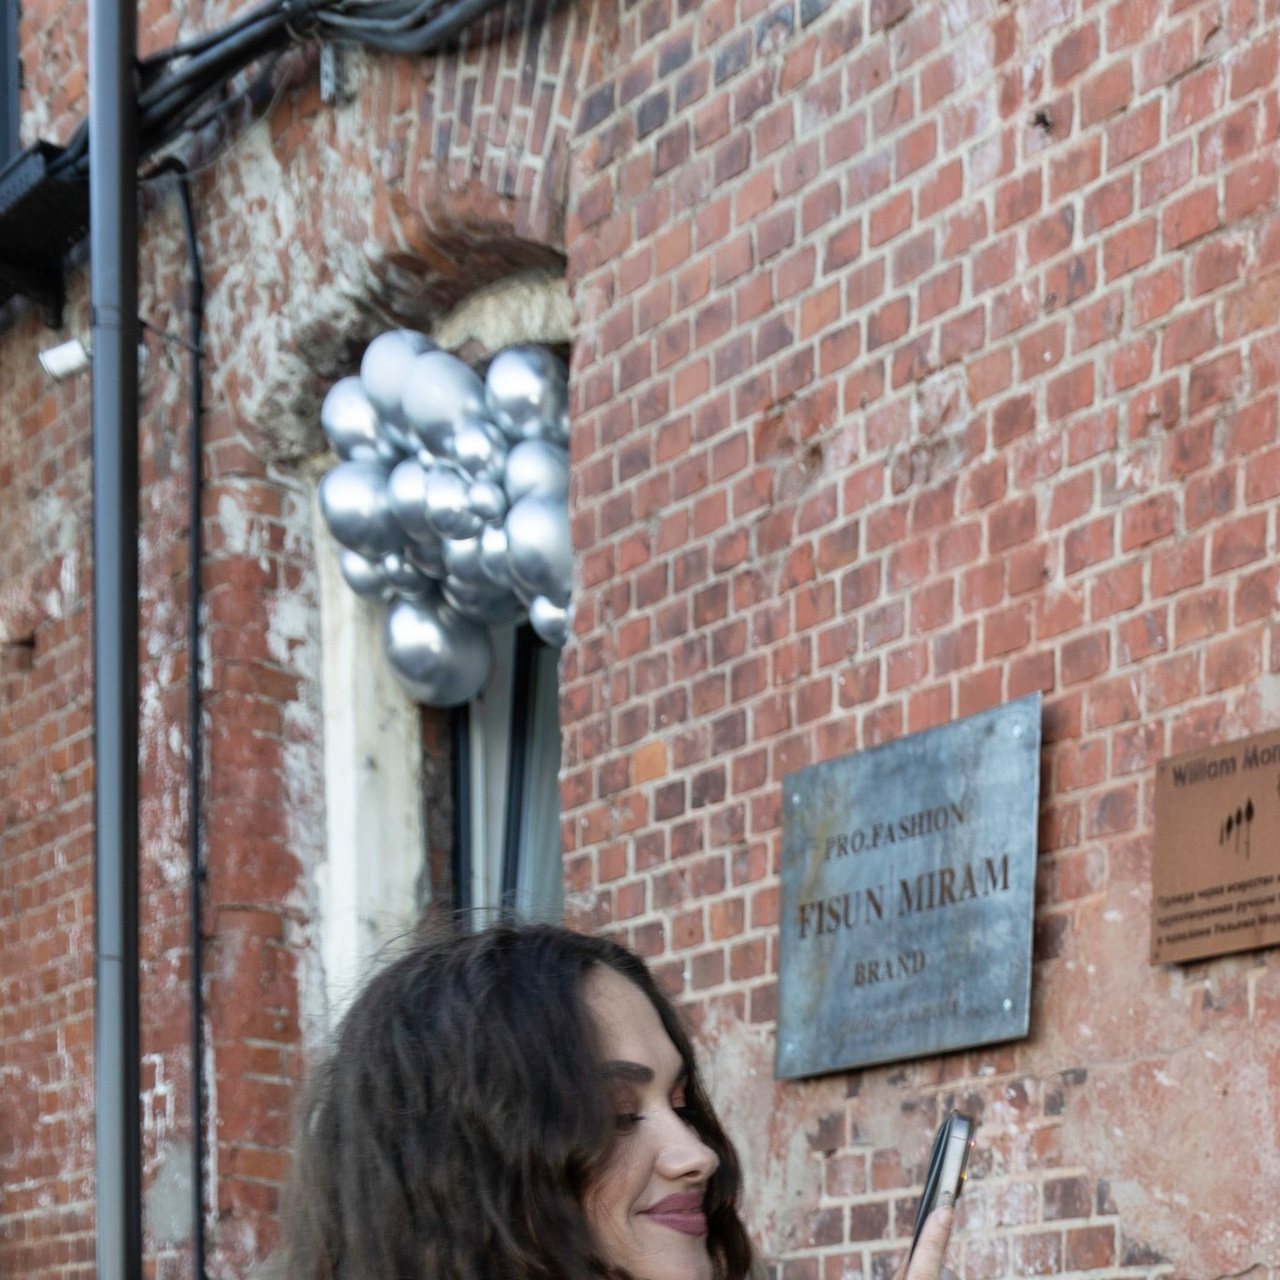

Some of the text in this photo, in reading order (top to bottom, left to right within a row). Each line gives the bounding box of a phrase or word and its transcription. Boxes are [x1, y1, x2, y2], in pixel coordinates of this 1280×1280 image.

[824, 802, 965, 861] PRO.FASHION
[797, 854, 1011, 939] FISUN MIRAM
[853, 950, 927, 988] BRAND
